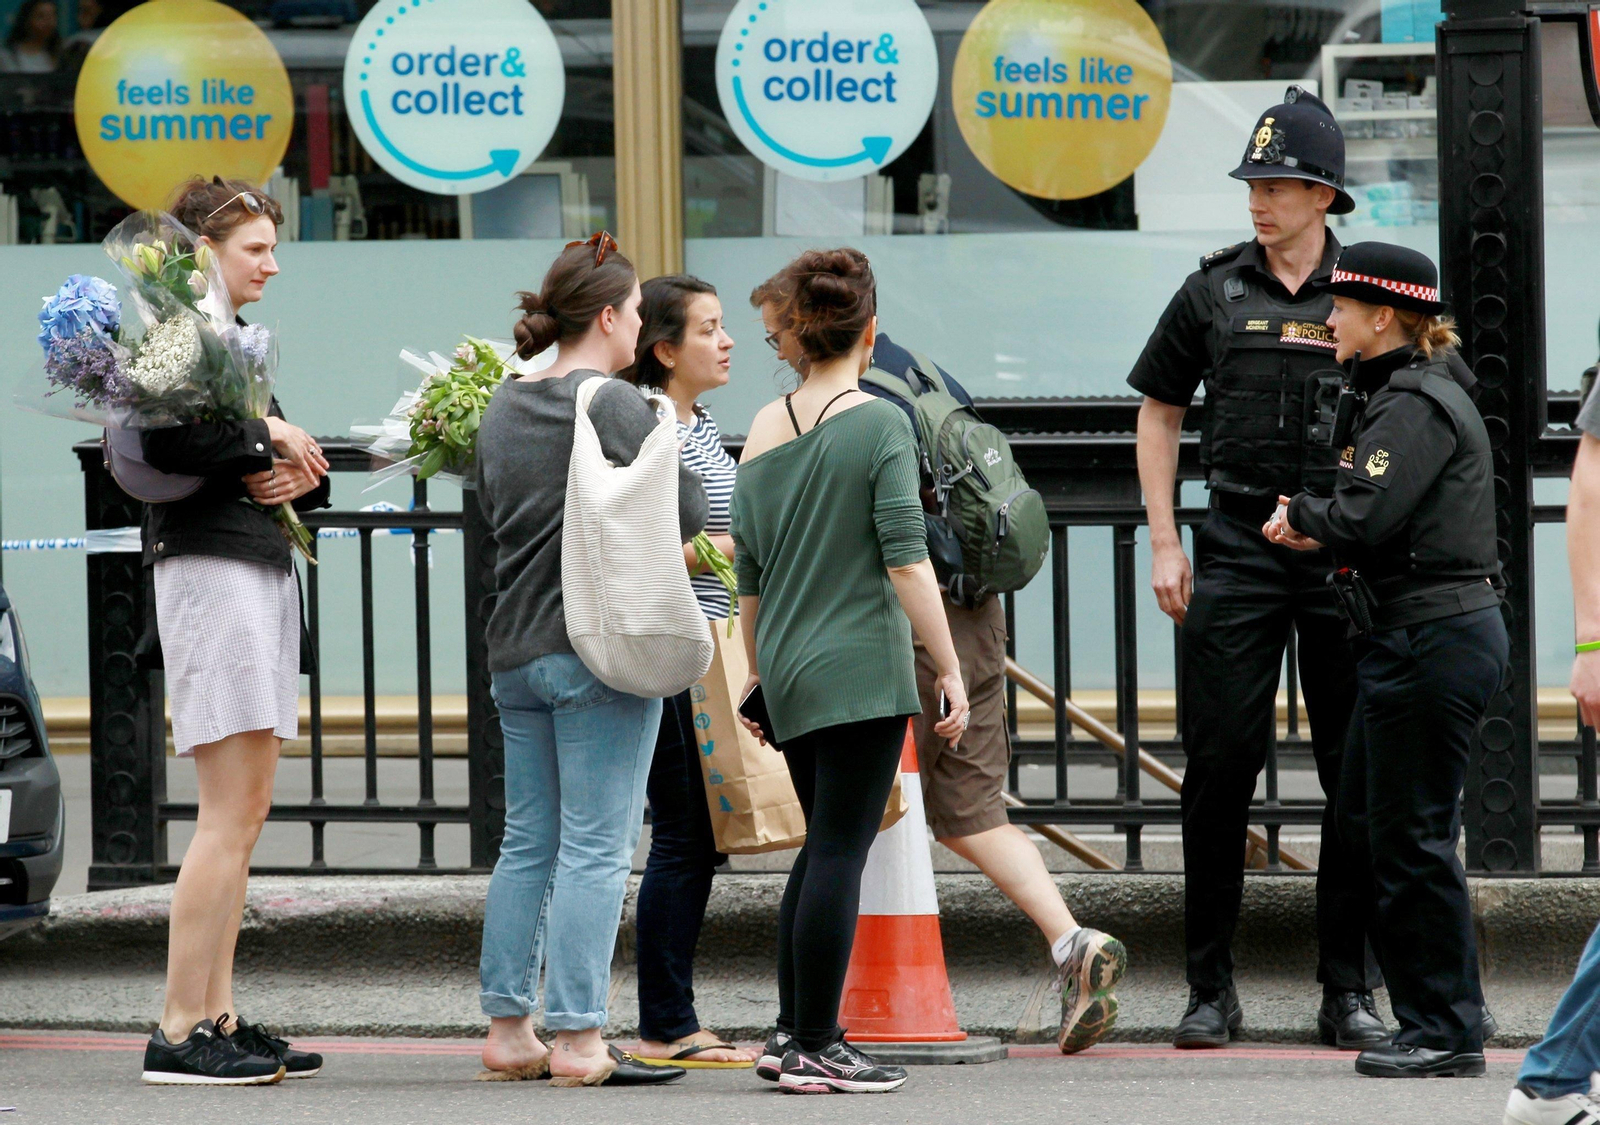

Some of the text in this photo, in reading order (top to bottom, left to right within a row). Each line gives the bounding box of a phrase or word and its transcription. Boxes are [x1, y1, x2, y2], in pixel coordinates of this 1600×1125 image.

[391, 45, 526, 77] order&
[763, 31, 899, 64] order&
[993, 55, 1133, 84] feels like
[117, 79, 255, 105] feels like
[391, 82, 524, 116] collect
[763, 68, 897, 103] collect
[975, 91, 1149, 120] summer
[99, 114, 272, 141] summer
[1369, 454, 1390, 468] 0340
[1376, 449, 1389, 458] CP
